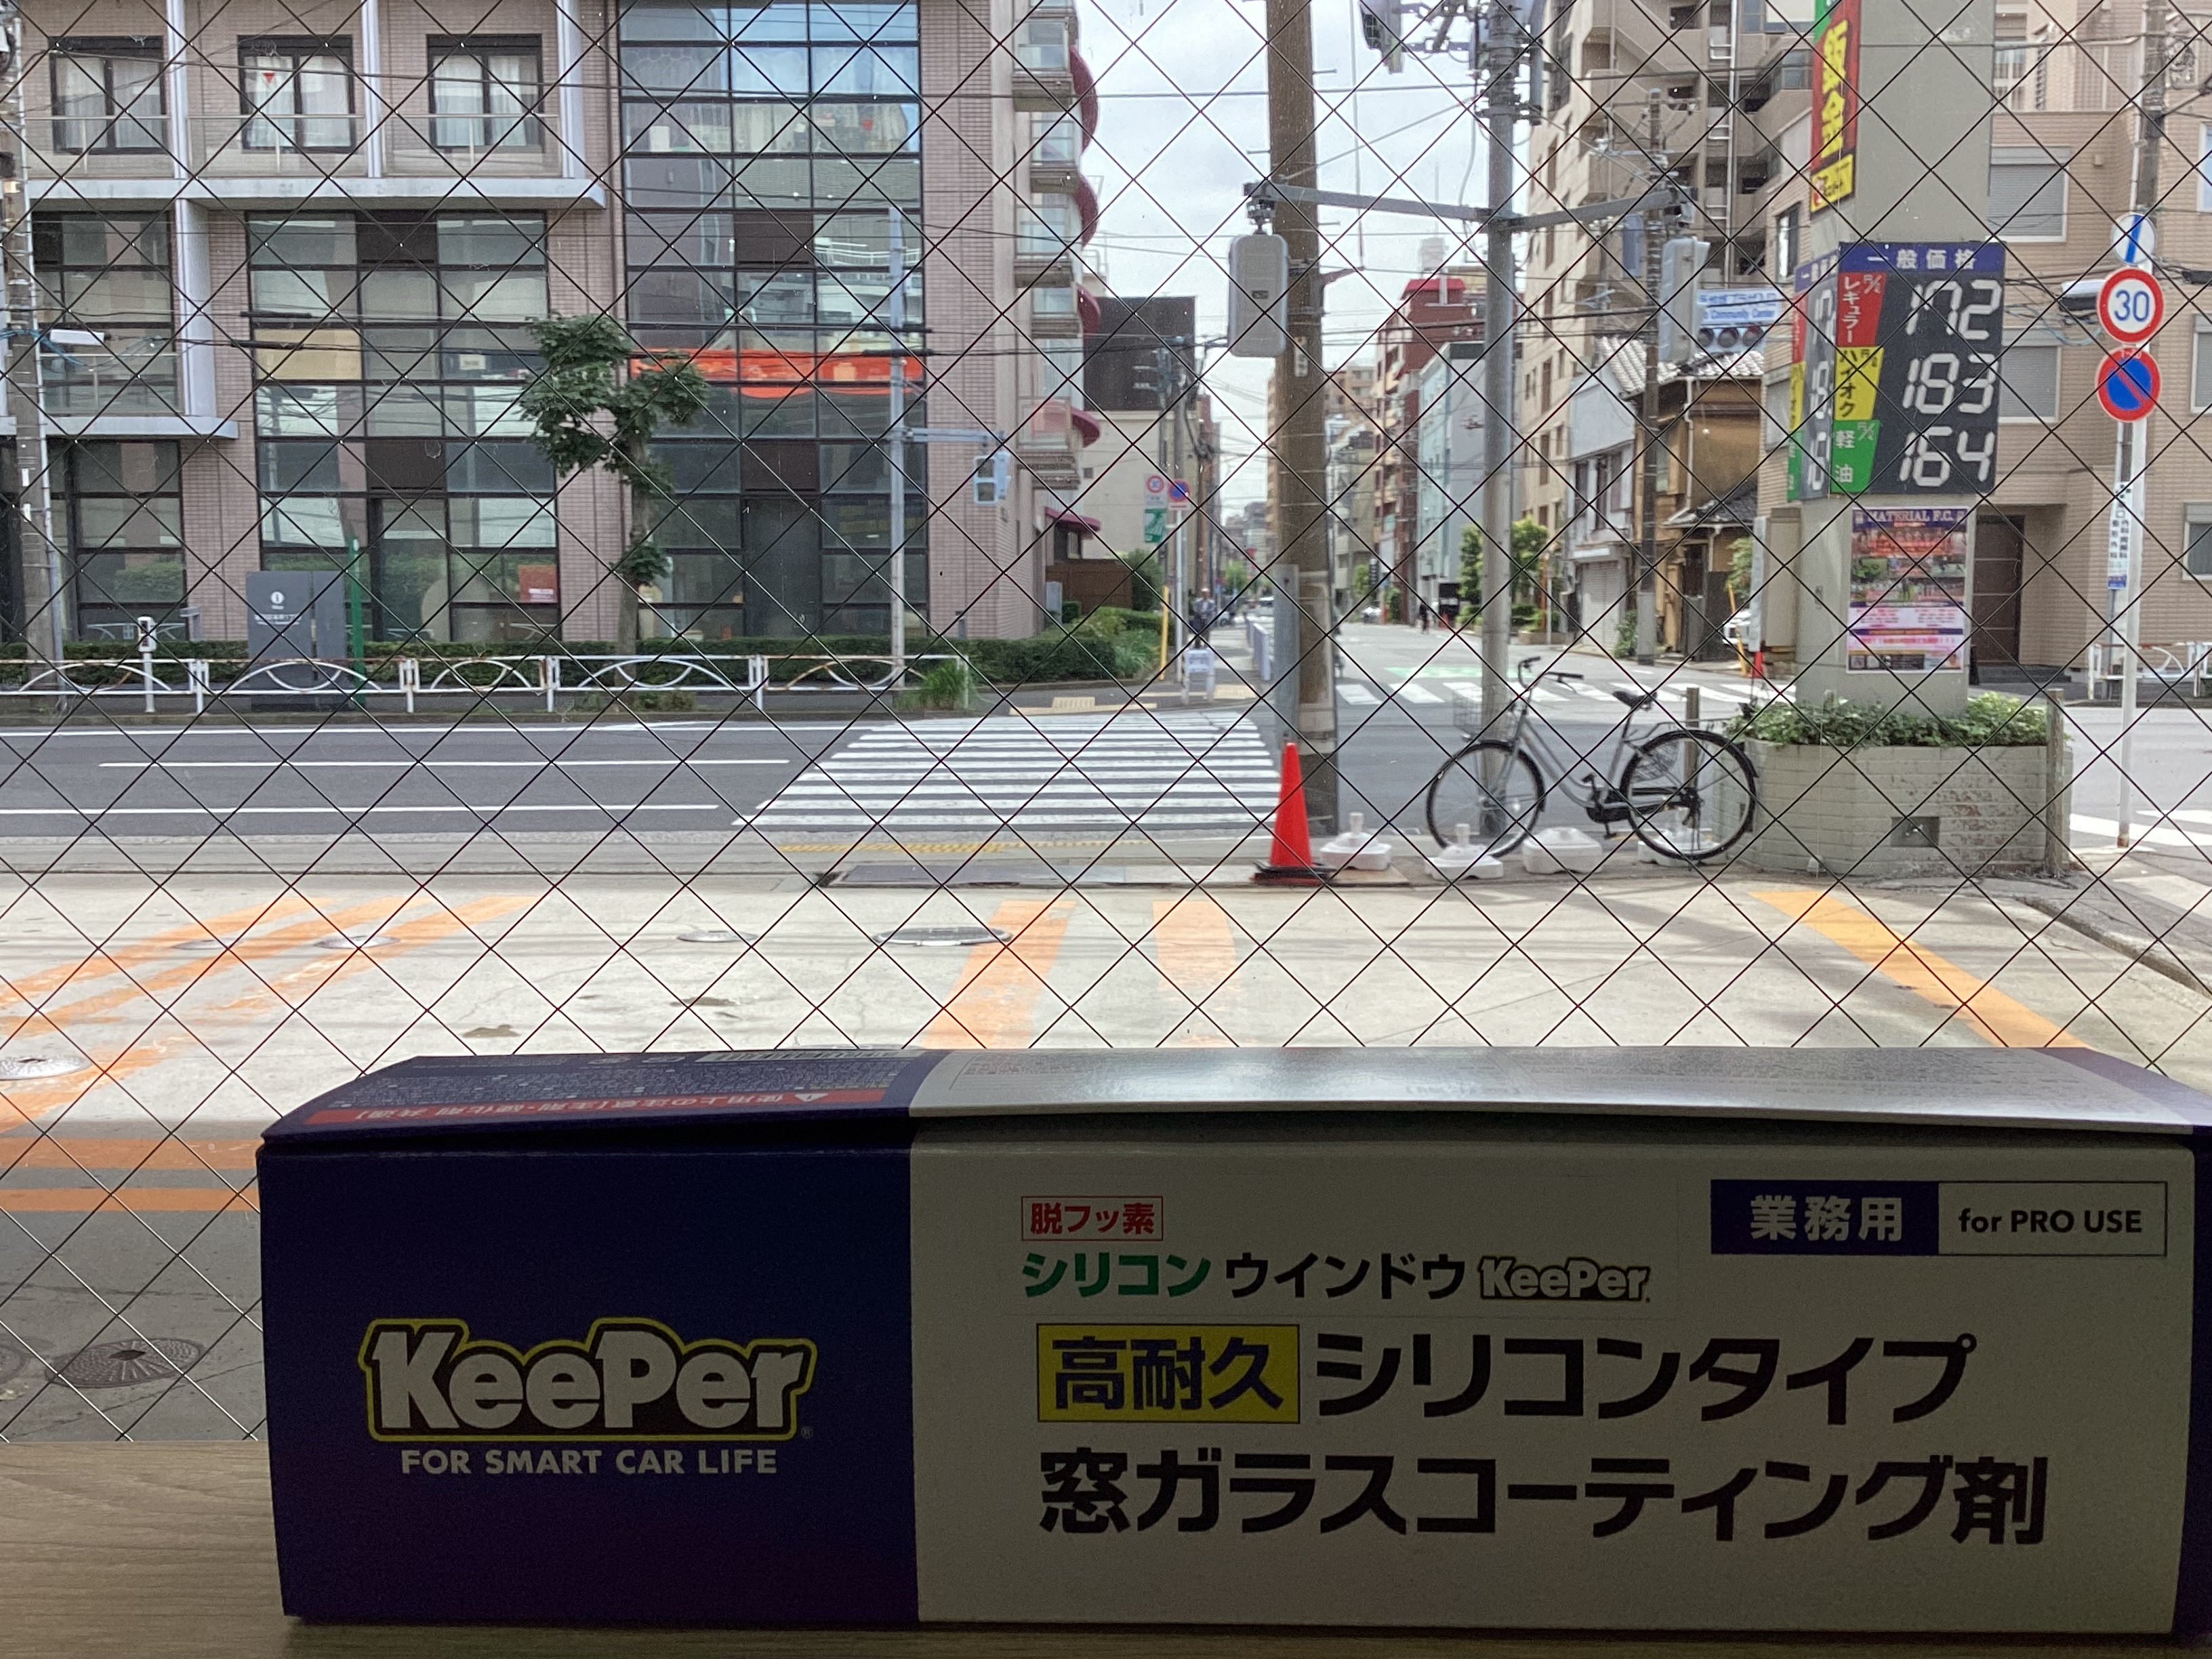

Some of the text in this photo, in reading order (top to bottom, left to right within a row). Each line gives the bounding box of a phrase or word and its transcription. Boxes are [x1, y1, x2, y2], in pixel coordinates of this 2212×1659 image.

[1867, 249, 1976, 269] 一般価格
[1906, 279, 2002, 340] 172
[2114, 289, 2150, 322] 30
[1839, 350, 1858, 417] ハイオク
[1902, 353, 1999, 414] 183
[1835, 430, 1855, 483] 軽油
[1900, 426, 1994, 487] 164
[1030, 1202, 1155, 1235] 脱フッ素
[1750, 1195, 1903, 1242] 業務用
[1959, 1207, 2142, 1233] for PRO USE
[1480, 1257, 1650, 1300] KeePer
[369, 1328, 806, 1431] KeePer
[1052, 1333, 1978, 1425] 高耐久 シリコンタイプ
[401, 1448, 777, 1475] FOR SMART CAR LIFE
[1038, 1446, 2049, 1545] 窓ガラスコーティング剤
